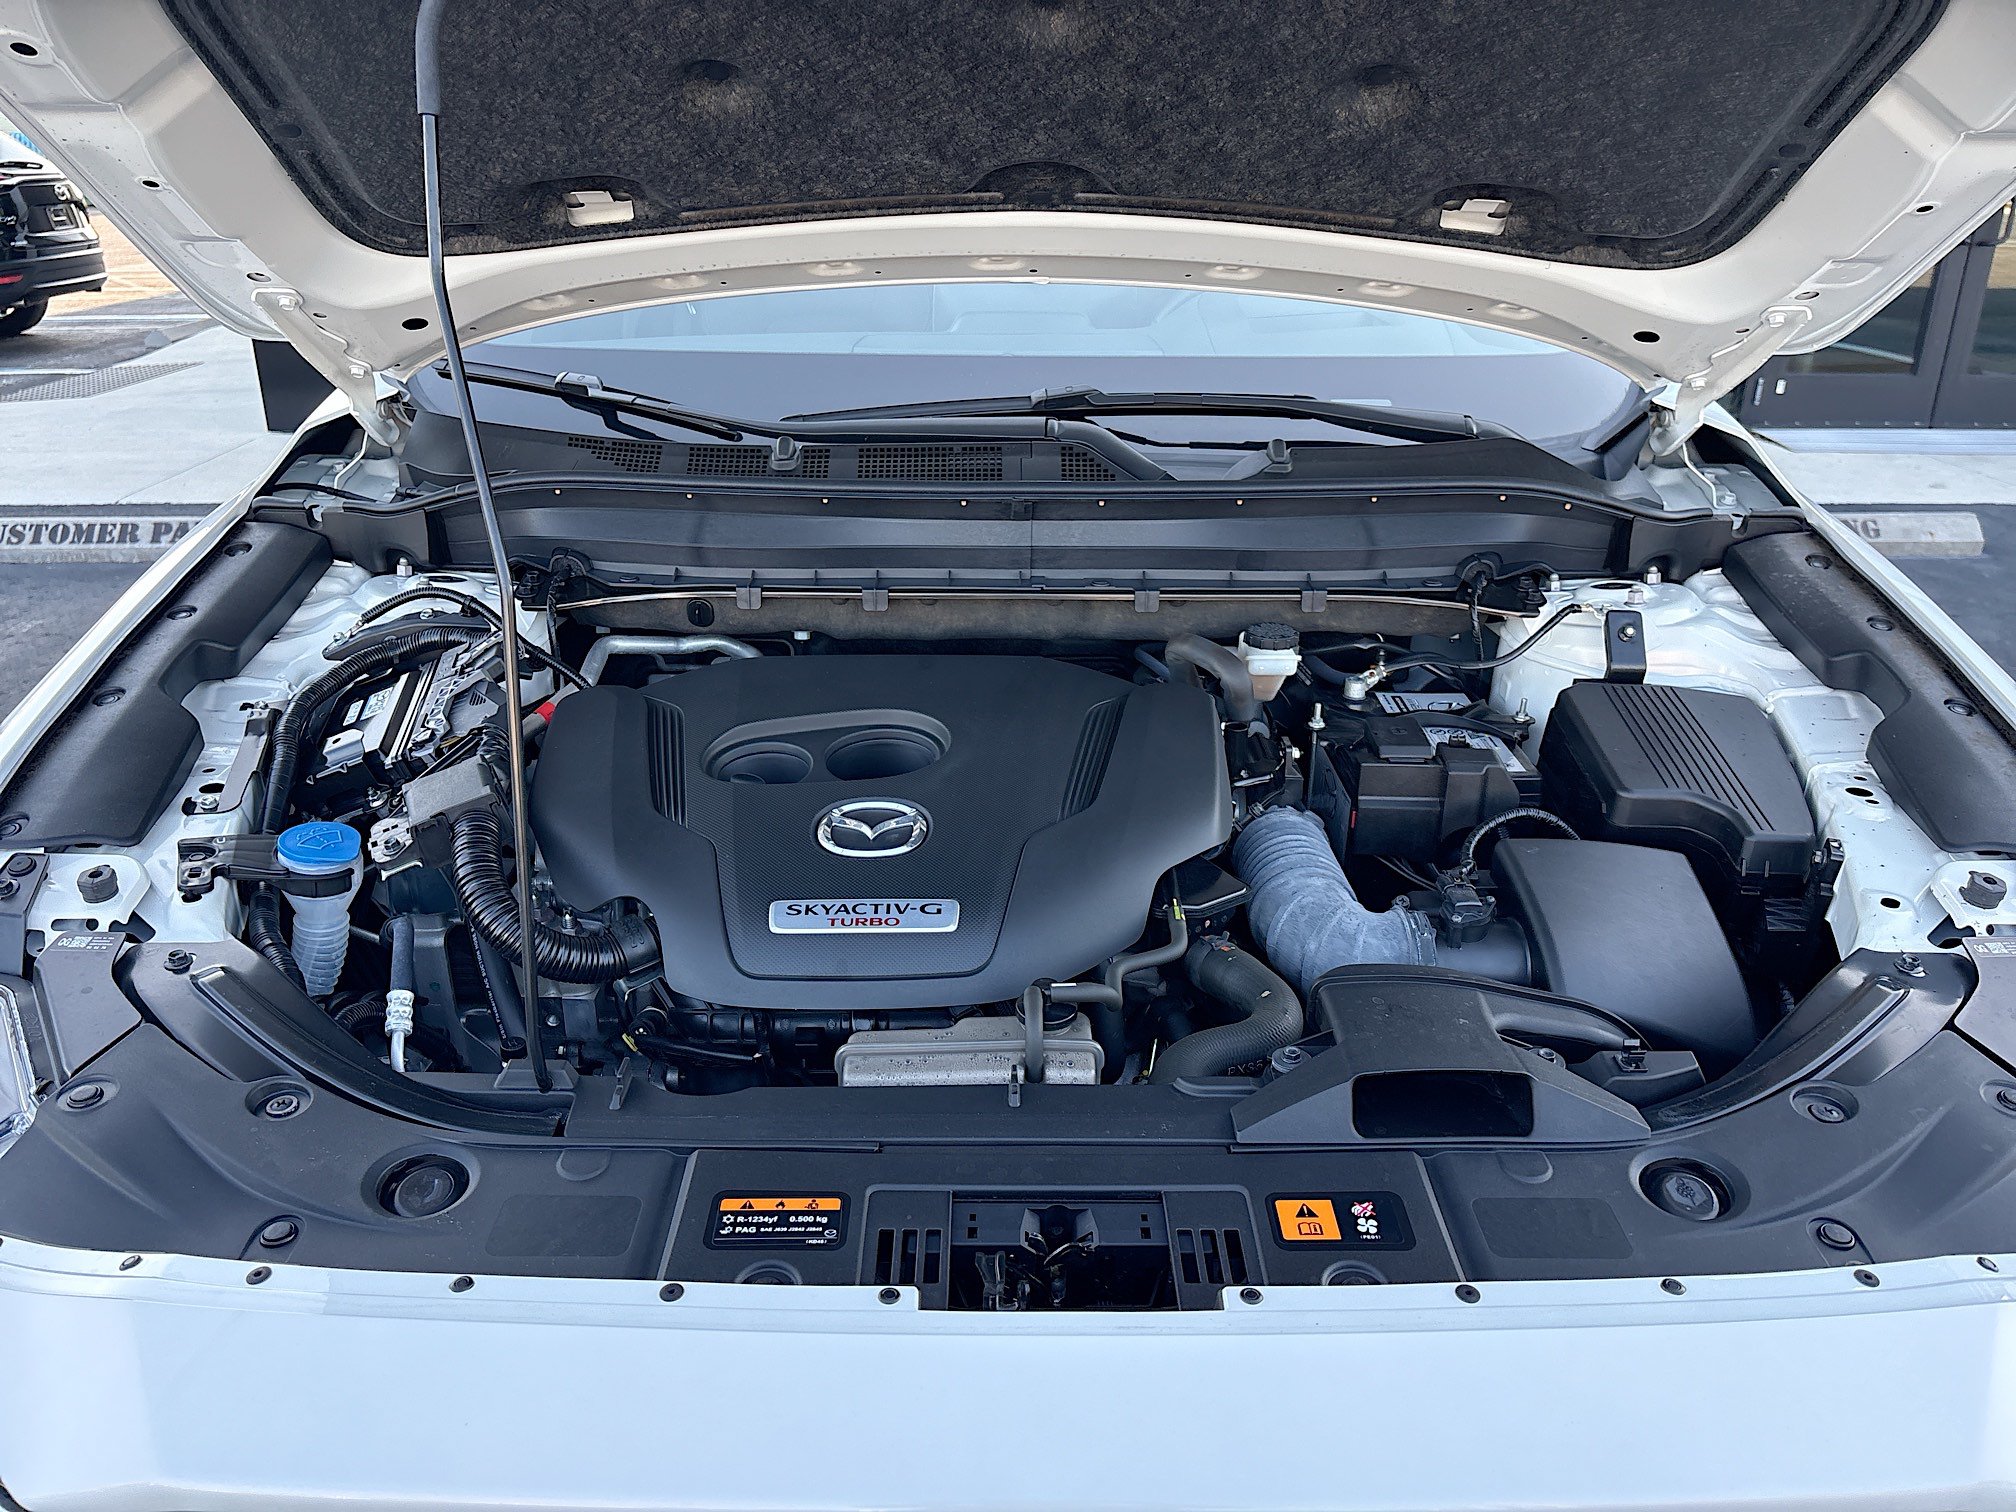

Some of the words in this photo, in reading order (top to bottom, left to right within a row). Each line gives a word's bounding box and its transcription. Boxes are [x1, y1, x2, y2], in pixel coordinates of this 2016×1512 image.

[785, 903, 942, 916] SKYACTIV-G
[826, 917, 900, 927] TURBO
[736, 1215, 779, 1224] R-1234yf
[789, 1215, 815, 1223] 0.500
[816, 1215, 828, 1224] kg
[735, 1226, 757, 1234] PAG
